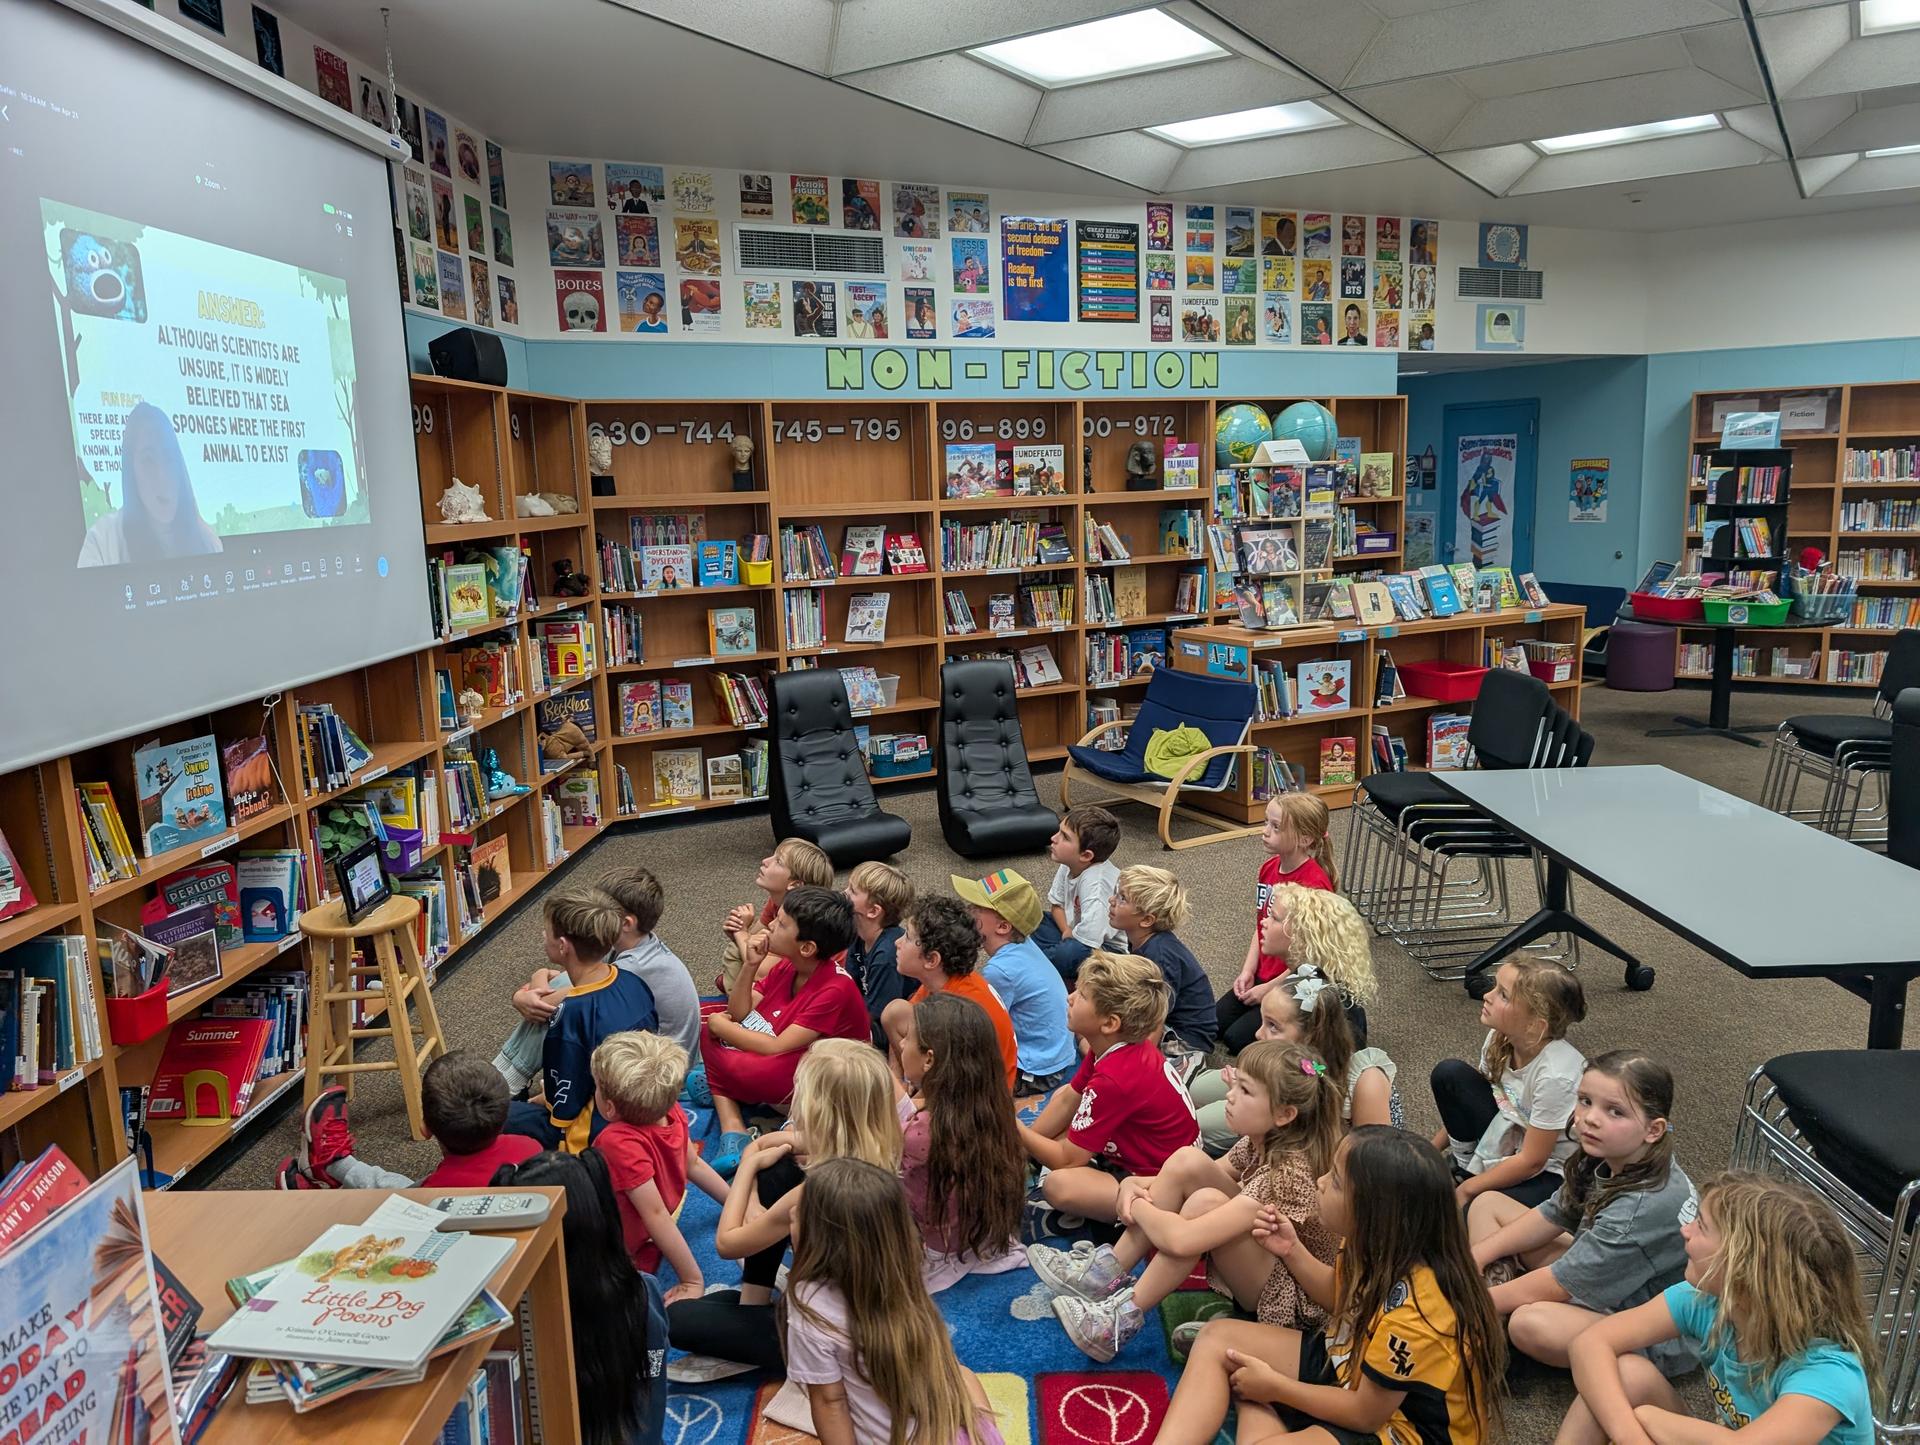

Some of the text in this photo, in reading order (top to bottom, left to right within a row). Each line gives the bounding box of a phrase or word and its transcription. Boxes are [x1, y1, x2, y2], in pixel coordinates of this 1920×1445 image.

[679, 174, 709, 186] Solar
[795, 180, 824, 189] ACTION
[794, 187, 826, 196] FIGURES
[548, 212, 559, 221] ALL
[564, 212, 578, 221] WAY
[1039, 223, 1050, 231] are
[1051, 222, 1062, 232] the
[1007, 232, 1059, 245] second defense
[903, 245, 932, 253] UNICORN
[1007, 245, 1015, 255] of
[1008, 263, 1035, 277] Reading
[557, 279, 602, 292] BONES
[1008, 276, 1044, 288] is the first
[1345, 286, 1362, 294] BTS
[1185, 298, 1219, 306] UNDEFEATED
[158, 325, 300, 363] ALTHOUGH SCIENTISTS ARE
[178, 357, 290, 387] UNSURE, IT IS WIDELY
[186, 386, 290, 412] BELIEVED THAT SEA
[79, 412, 102, 425] THERE
[104, 414, 119, 425] ARE
[172, 414, 306, 438] SPONGES WERE THE FIRST
[511, 414, 520, 439] 9
[937, 418, 1047, 441] 96-899
[90, 429, 121, 441] SPECIES
[83, 445, 114, 457] KNOWN,
[1460, 438, 1515, 452] Superheroes are
[203, 444, 288, 462] ANIMAL TO EXIST
[1019, 449, 1063, 458] UNDEFEATED
[1462, 450, 1482, 463] Super
[94, 461, 104, 472] BE
[1167, 459, 1195, 468] TAJ MAHAL
[1571, 460, 1609, 470] PERSEVERANCE
[651, 557, 685, 566] DYSLEXIA
[1314, 663, 1338, 674] Frida
[670, 686, 688, 696] BITE
[184, 760, 209, 776] SINKING
[661, 757, 694, 768] Solar
[185, 783, 214, 802] FLOATING
[234, 792, 252, 806] What's
[238, 791, 269, 818] Haboob?
[168, 872, 231, 903] PERIODIC
[156, 920, 205, 941] WEATHERING
[175, 926, 206, 942] EROSION
[186, 1030, 240, 1041] Summer
[64, 1072, 79, 1083] MATH
[20, 1200, 34, 1213] D.
[32, 1159, 67, 1201] JACKSON
[302, 1284, 426, 1319] Little Dog
[312, 1306, 399, 1328] Poems
[1, 1302, 53, 1359] MAKE
[361, 1331, 390, 1341] George
[0, 1297, 88, 1396] ODAY
[24, 1337, 89, 1406] DAY TO
[0, 1369, 86, 1445] READ
